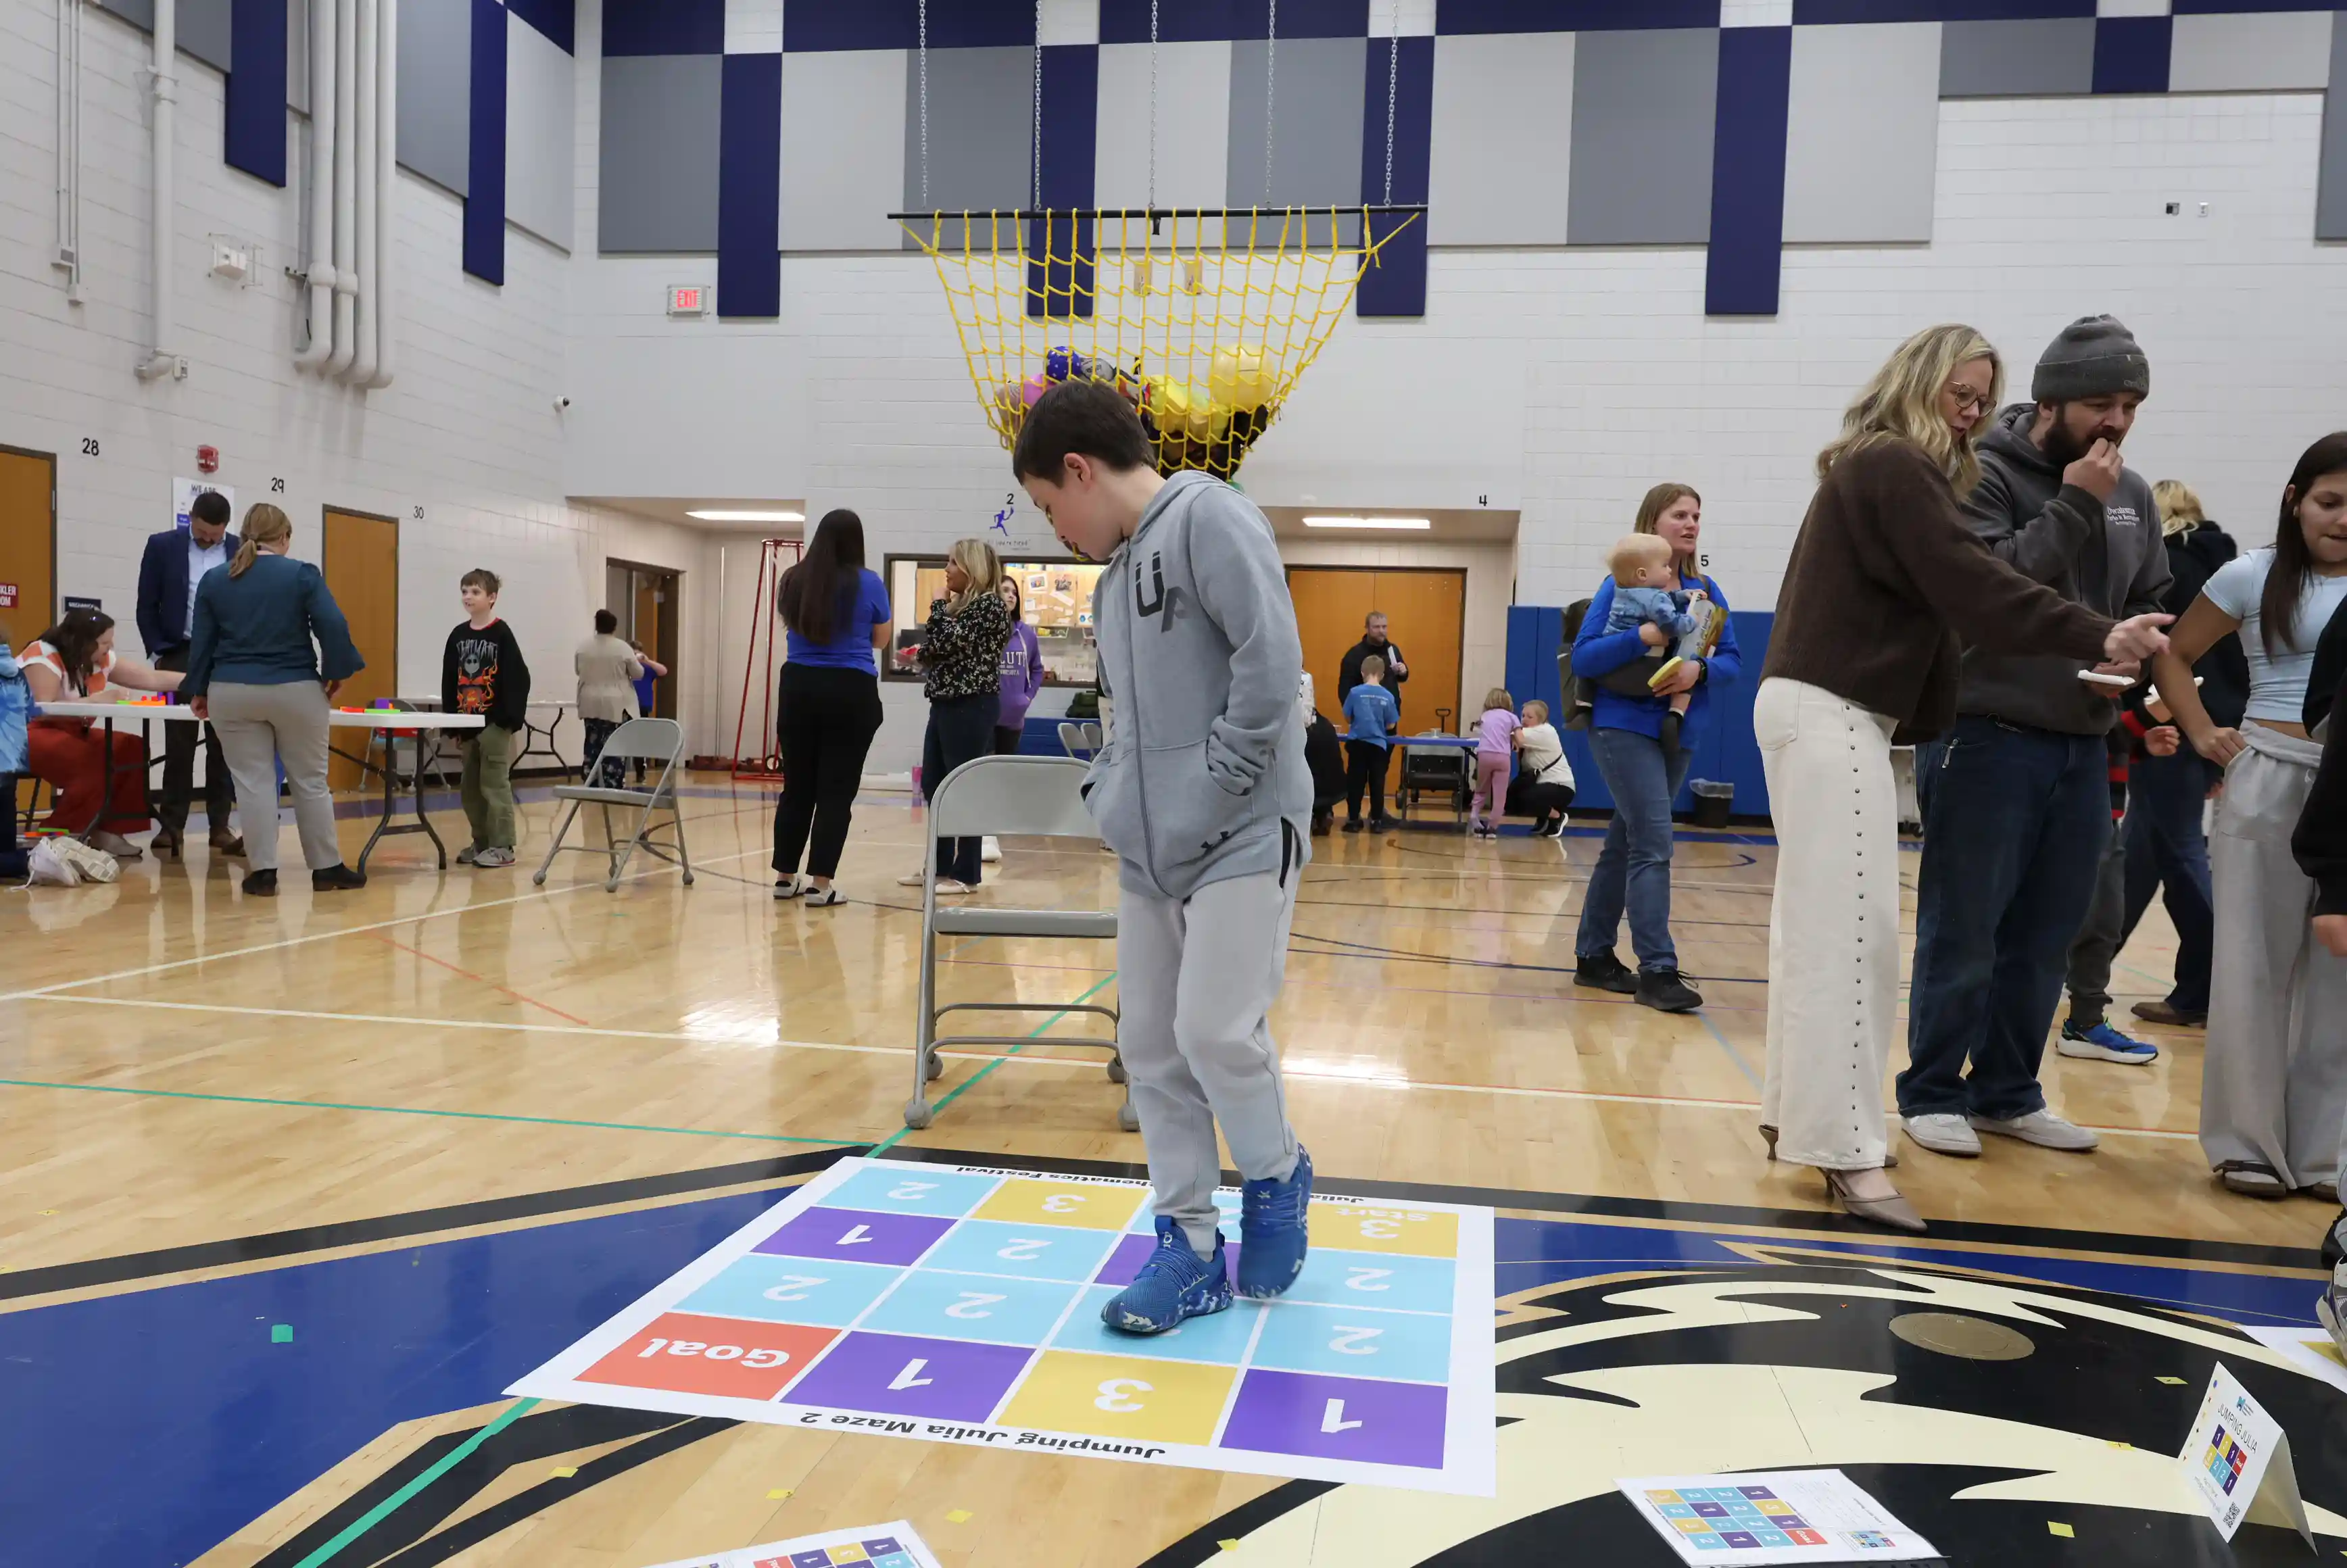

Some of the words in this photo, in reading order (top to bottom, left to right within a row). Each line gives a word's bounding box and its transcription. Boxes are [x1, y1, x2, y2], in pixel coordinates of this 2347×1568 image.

[677, 289, 697, 308] EXIT
[82, 437, 99, 456] 28
[271, 477, 285, 494] 29
[1006, 493, 1015, 505] 2
[1478, 494, 1488, 507] 4
[413, 506, 425, 520] 30
[1700, 555, 1710, 567] 5
[957, 1167, 1042, 1179] Festival
[1049, 1173, 1153, 1187] hematics
[886, 1181, 940, 1201] 2
[1041, 1194, 1087, 1213] 3
[1335, 1207, 1430, 1222] Start
[836, 1224, 873, 1246] 1
[1359, 1219, 1401, 1240] 3
[997, 1238, 1052, 1260] 2
[763, 1274, 829, 1302] 2
[1345, 1267, 1394, 1292] 2
[945, 1291, 1008, 1319] 2
[1329, 1325, 1384, 1355] 2
[637, 1338, 790, 1369] Goal
[887, 1358, 934, 1391] 1
[1094, 1377, 1155, 1413] 3
[800, 1413, 823, 1423] 2
[831, 1415, 917, 1434] Maze
[1320, 1398, 1363, 1434] 1
[927, 1425, 1008, 1442] Julia
[2217, 1433, 2221, 1441] 1
[2218, 1403, 2242, 1436] JUMPING
[2241, 1430, 2258, 1454] JULIA
[1015, 1432, 1165, 1459] Jumping
[2230, 1450, 2235, 1459] 1
[2213, 1461, 2219, 1470] 2
[2228, 1479, 2233, 1488] 1
[1795, 1529, 1816, 1544] Goal
[885, 1559, 901, 1567] 2
